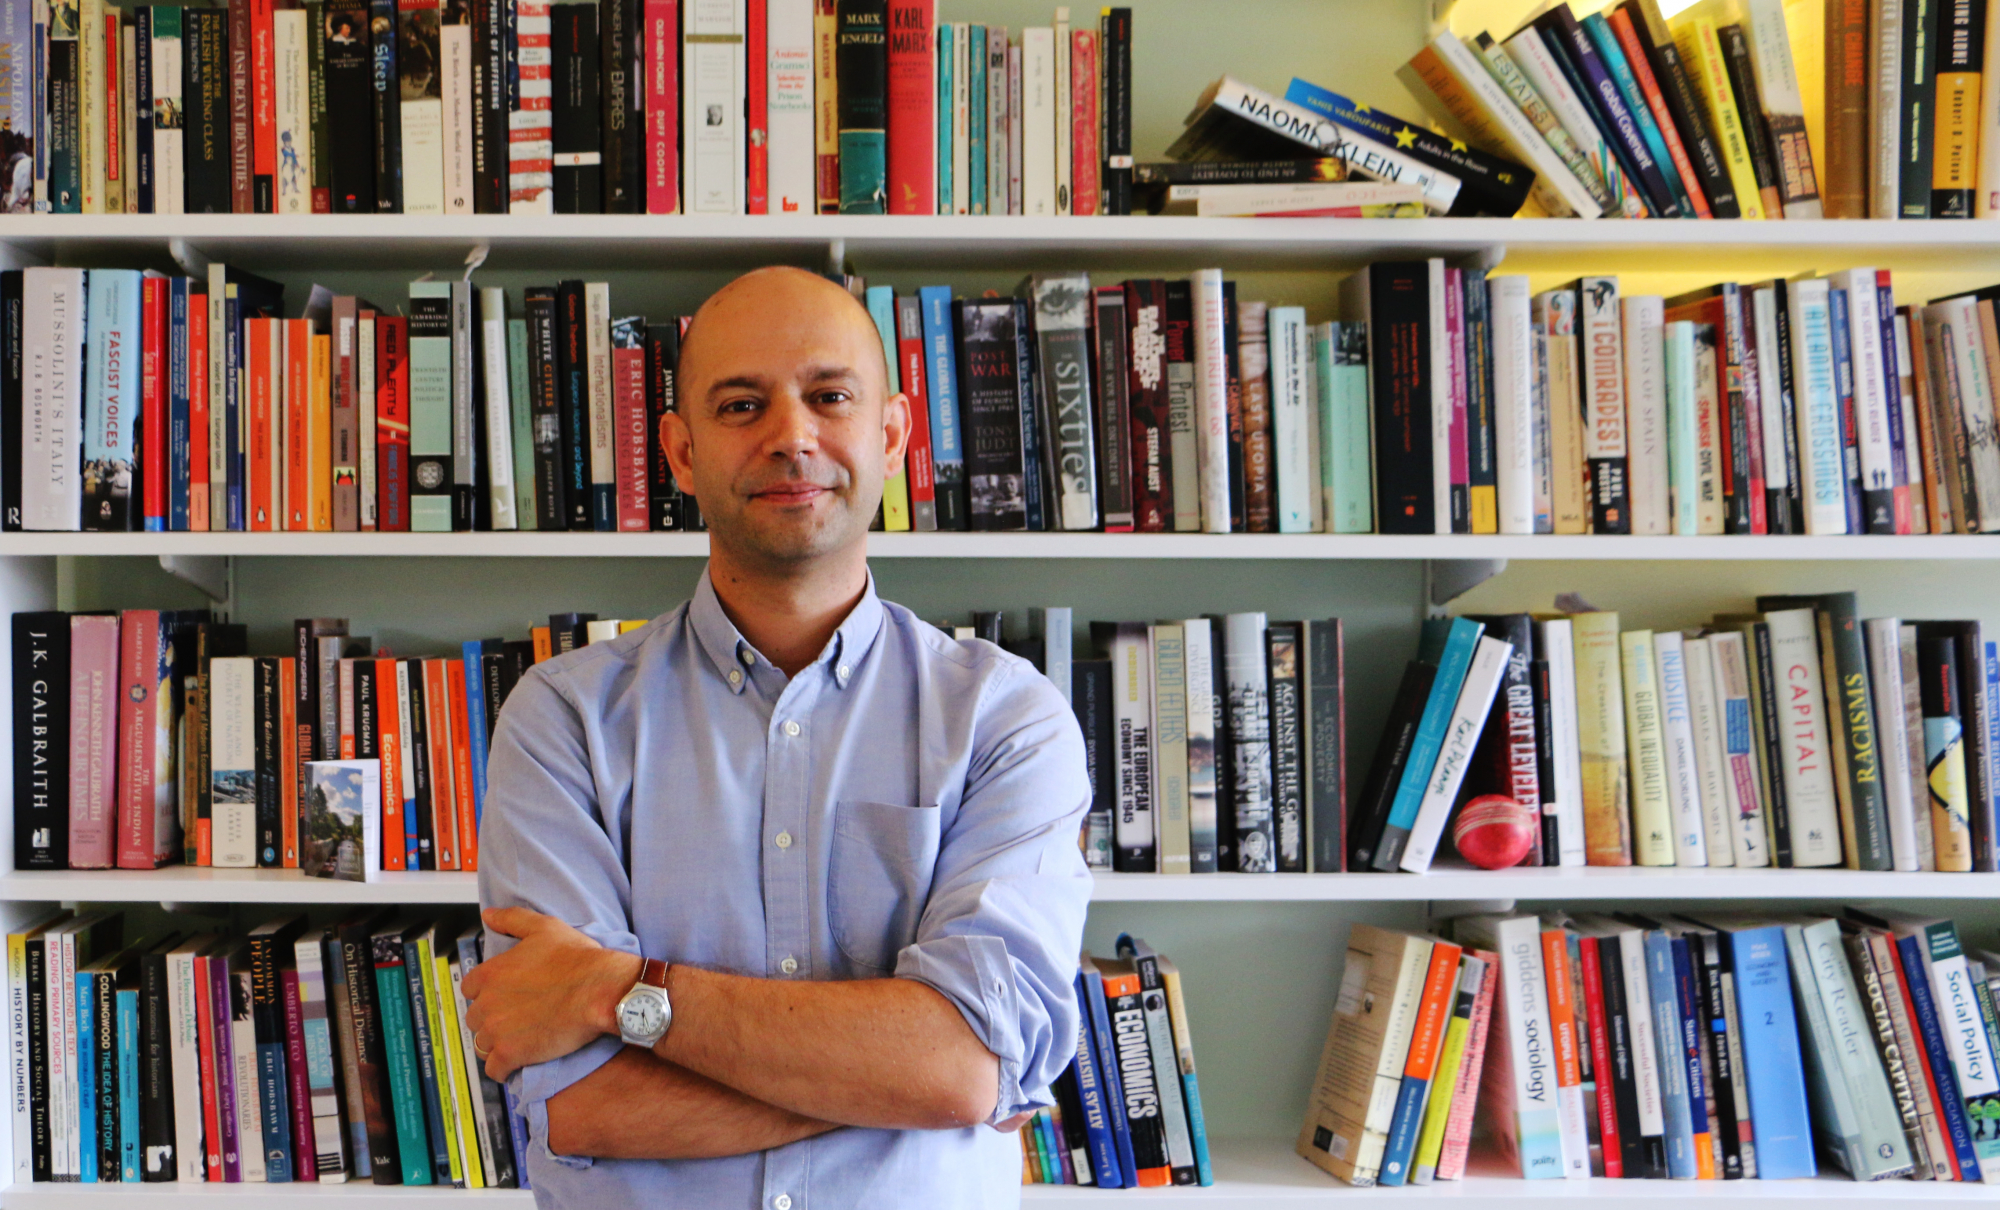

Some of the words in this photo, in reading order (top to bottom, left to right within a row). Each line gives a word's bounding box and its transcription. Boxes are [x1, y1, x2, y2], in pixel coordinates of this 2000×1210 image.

[201, 14, 210, 61] ENGLISH
[656, 19, 664, 37] OLD
[846, 14, 880, 24] MARX
[894, 8, 924, 30] KARL
[491, 38, 498, 52] OF
[656, 40, 664, 60] MEN
[892, 33, 926, 54] MARX
[234, 49, 246, 119] INSURGENT
[374, 43, 389, 91] Sleep
[491, 55, 499, 110] SUFFERING
[656, 62, 664, 95] FORGET
[53, 80, 61, 121] THOMAS
[202, 64, 212, 120] WORKING
[1492, 53, 1548, 124] ESTATES
[54, 124, 62, 152] PAINE
[204, 124, 213, 160] CLASS
[657, 110, 665, 136] DUFF
[1600, 79, 1620, 115] Global
[1618, 112, 1652, 170] Covenant
[235, 122, 247, 190] IDENTITIES
[476, 140, 484, 173] FAUST
[656, 142, 665, 187] COOPER
[1335, 142, 1402, 182] KLEIN
[51, 291, 65, 419] MUSSOLINI'S
[228, 331, 236, 367] Sexuality
[386, 324, 396, 353] RED
[542, 318, 552, 361] WHITE
[935, 334, 946, 354] THE
[1167, 320, 1189, 360] Power
[1805, 310, 1831, 394] ATLANTIC
[34, 354, 42, 382] R.J.B.
[108, 331, 120, 391] FASCIST
[630, 359, 642, 400] ERIC
[936, 357, 949, 395] GLOBAL
[970, 364, 1012, 376] WAR
[228, 377, 236, 406] Europe
[544, 364, 554, 407] CITIES
[593, 354, 608, 449] Internationalisms
[1250, 382, 1262, 422] LAST
[34, 388, 42, 443] BOSWORTH
[106, 395, 118, 448] VOICES
[940, 398, 952, 426] COLD
[1170, 381, 1192, 434] Protest
[51, 428, 63, 487] ITALY
[632, 408, 646, 509] HOBSBAWM
[942, 428, 953, 450] WAR
[1147, 427, 1159, 463] STEFAN
[1810, 404, 1839, 500] CROSSINGS
[1148, 465, 1160, 492] AUST
[1251, 430, 1265, 493] UTOPIA
[623, 464, 632, 509] TIMES
[30, 632, 47, 669] J.K.
[300, 627, 308, 701] EICHENGREEN
[324, 656, 335, 676] The
[1157, 639, 1182, 685] GOLDEN
[1508, 653, 1528, 682] The
[91, 670, 103, 700] JOHN
[324, 679, 335, 700] Age
[1662, 650, 1687, 724] INJUSTICE
[91, 702, 103, 756] KENNETH
[325, 703, 336, 717] of
[362, 704, 371, 753] KRUGMAN
[1159, 693, 1184, 744] FETTERS
[1282, 683, 1296, 754] AGAINST
[1507, 685, 1533, 737] GREAT
[1634, 691, 1655, 734] GLOBAL
[1788, 664, 1818, 776] CAPITAL
[1844, 673, 1876, 783] RACISMS
[33, 680, 48, 808] GALBRAITH
[133, 708, 143, 802] ARGUMENTATIVE
[1120, 718, 1132, 765] ECONOMY
[1133, 726, 1148, 748] THE
[91, 758, 102, 820] GALBRAITH
[383, 733, 396, 815] Economics
[1121, 768, 1132, 796] SINCE
[1134, 751, 1149, 812] EUROPEAN
[1286, 759, 1297, 793] THE
[1640, 738, 1662, 802] INEQUALITY
[133, 805, 141, 846] INDIAN
[1122, 800, 1134, 824] 1945
[50, 941, 60, 984] READING
[64, 943, 73, 979] HISTORY
[250, 940, 266, 1005] PEOPLE
[344, 943, 355, 961] On
[80, 986, 89, 1007] Marc
[346, 963, 361, 1016] Historical
[1431, 960, 1448, 997] SOCIAL
[1512, 944, 1540, 1013] giddens
[1818, 943, 1838, 981] City
[1830, 989, 1859, 1056] Reader
[13, 988, 23, 1037] HISTORY
[51, 987, 60, 1028] PRIMARY
[65, 982, 74, 1018] BEYOND
[81, 1009, 90, 1032] Bloch
[100, 976, 110, 1049] COLLINGWOOD
[286, 982, 298, 1034] UMBERTO
[1764, 1012, 1775, 1026] 2
[67, 1020, 75, 1035] THE
[67, 1037, 75, 1056] TEXT
[355, 1018, 368, 1064] Distance
[1416, 1002, 1442, 1064] MOVEMENTS
[1684, 1019, 1695, 1048] States
[1946, 971, 1968, 1024] Social
[1961, 1029, 1985, 1081] Policy
[15, 1040, 23, 1055] BY
[52, 1031, 62, 1074] SOURCES
[102, 1051, 111, 1069] THE
[265, 1052, 274, 1075] ERIC
[290, 1040, 300, 1062] ECO
[1114, 1008, 1158, 1120] ECONOMICS
[1524, 1019, 1546, 1102] sociology
[1864, 972, 1892, 1041] SOCIAL
[1885, 1044, 1916, 1123] CAPITAL
[16, 1058, 25, 1113] NUMBERS
[103, 1071, 112, 1094] IDEA
[1688, 1059, 1701, 1098] Citizens
[103, 1096, 112, 1108] OF
[267, 1079, 278, 1134] HOBSBAWM
[103, 1109, 113, 1151] HISTORY
[1532, 1155, 1556, 1168] polity
